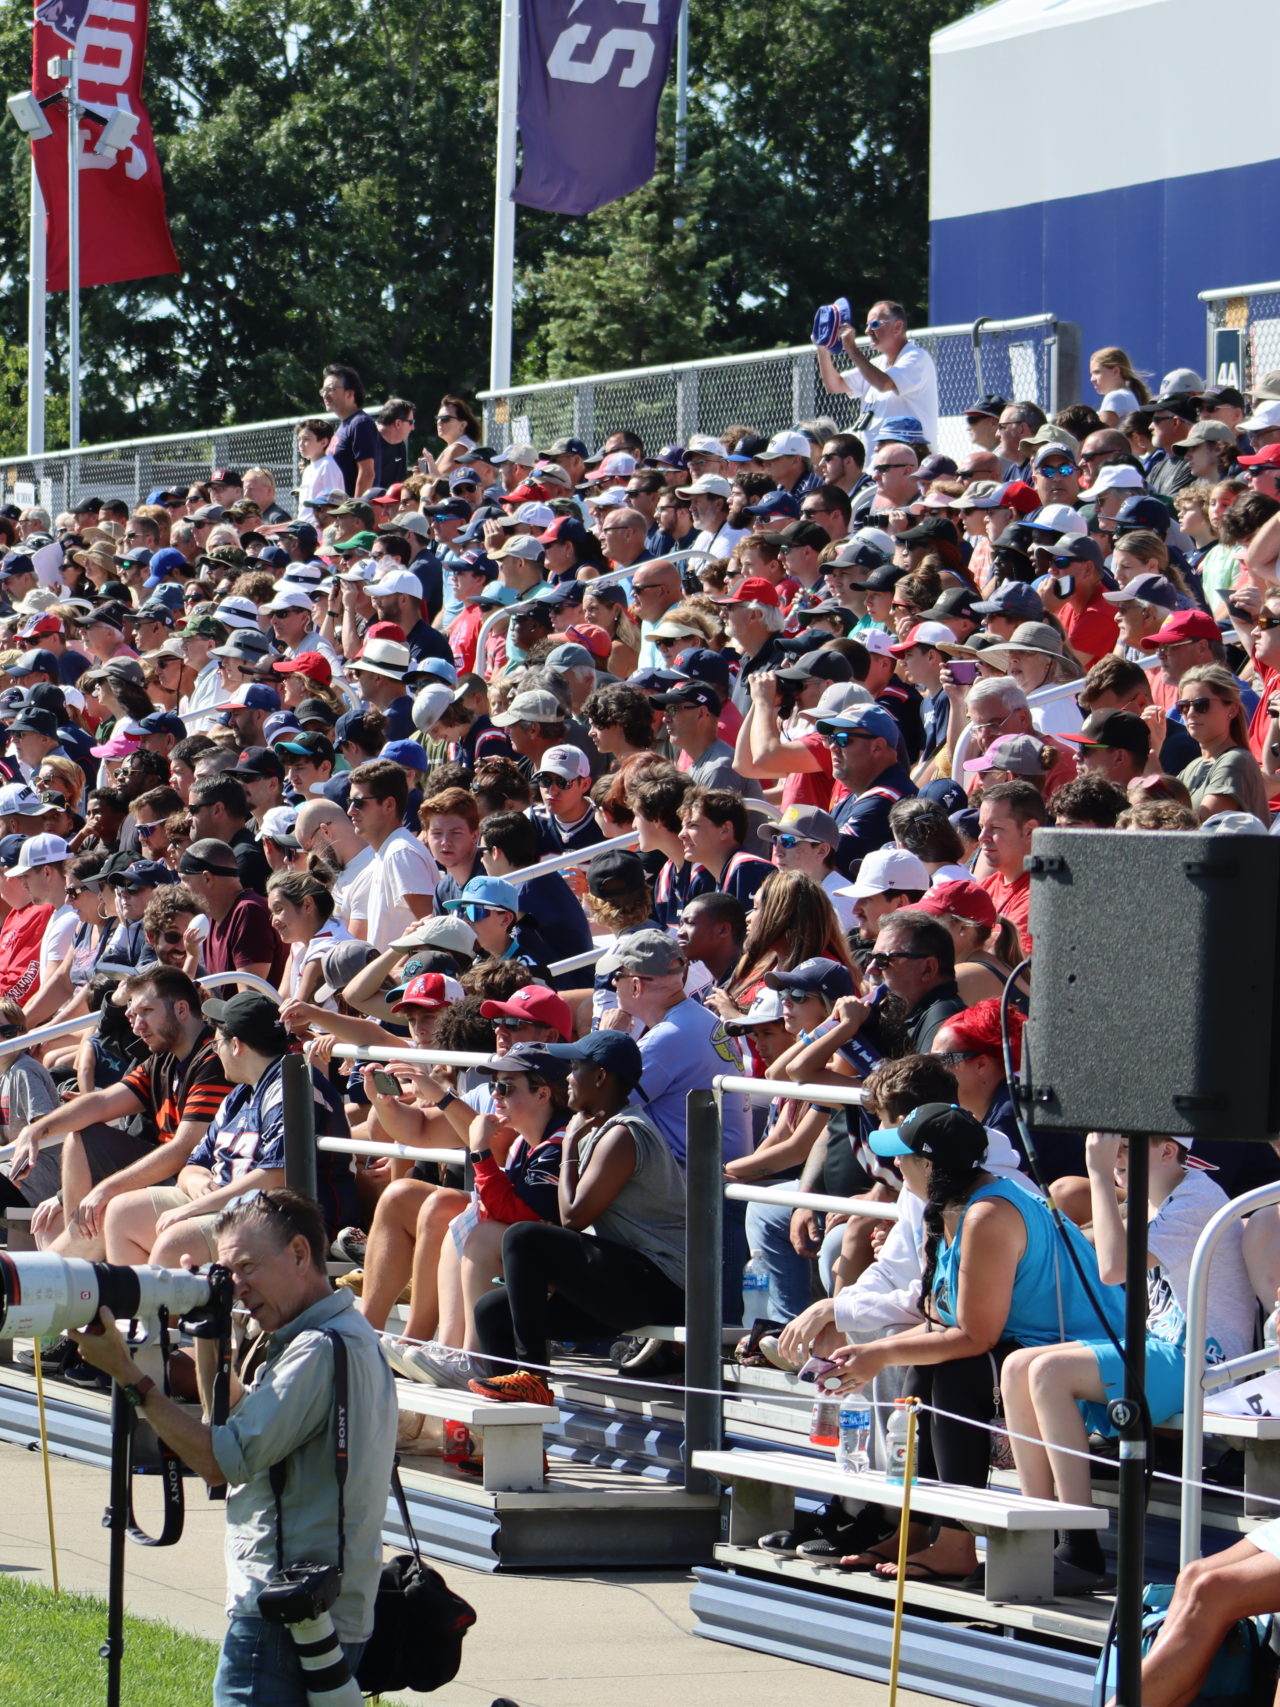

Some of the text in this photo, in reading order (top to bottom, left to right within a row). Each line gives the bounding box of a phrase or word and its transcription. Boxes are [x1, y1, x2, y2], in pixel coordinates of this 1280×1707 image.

[339, 1407, 347, 1449] SONY
[453, 1427, 466, 1442] G
[167, 1460, 180, 1504] SONY
